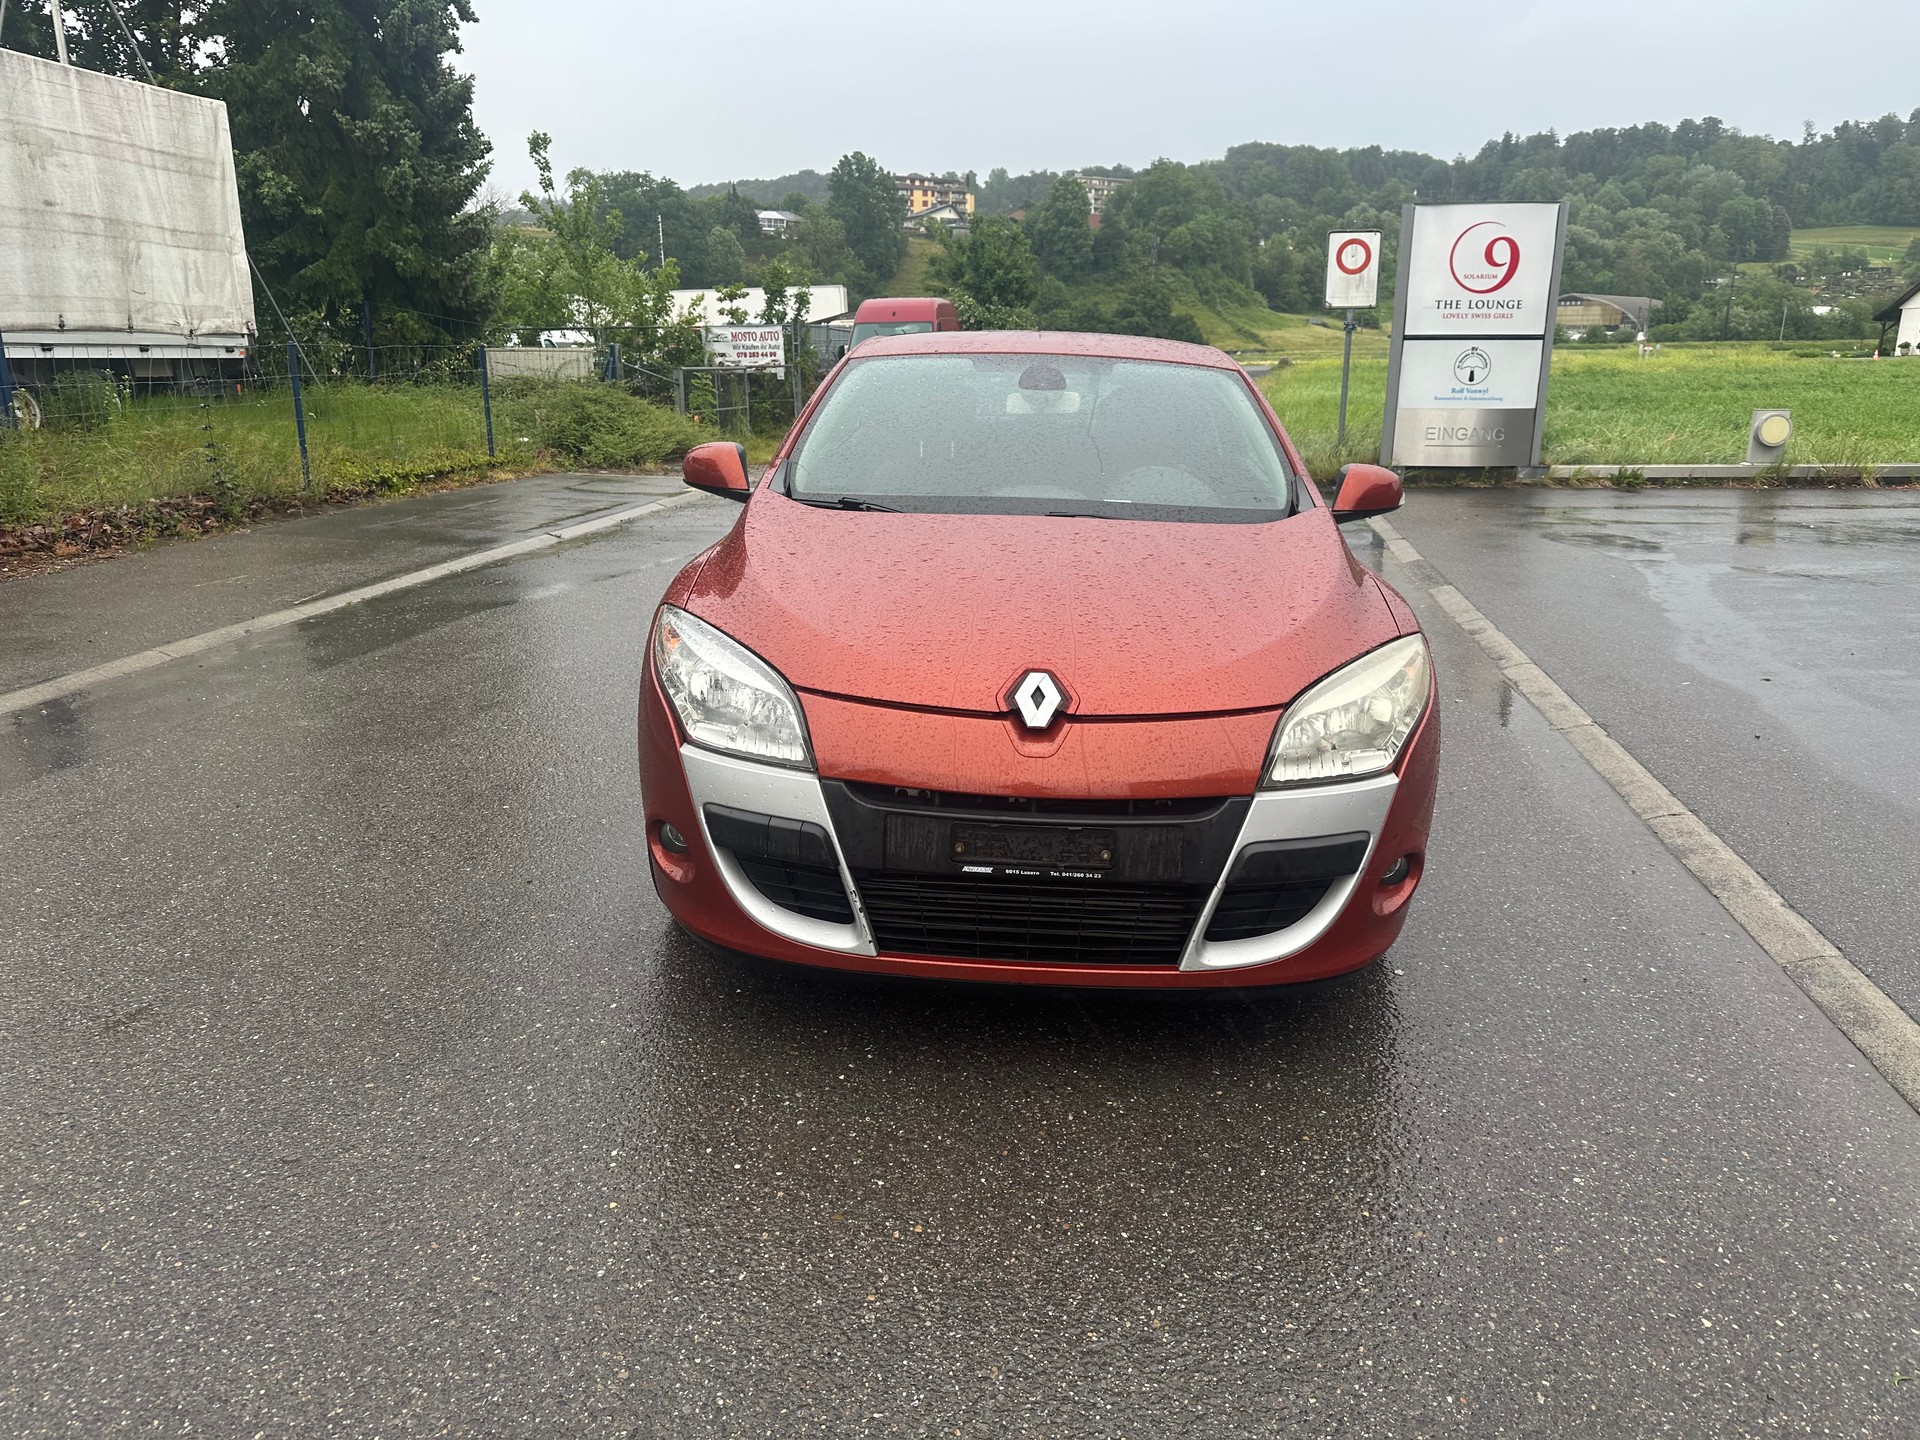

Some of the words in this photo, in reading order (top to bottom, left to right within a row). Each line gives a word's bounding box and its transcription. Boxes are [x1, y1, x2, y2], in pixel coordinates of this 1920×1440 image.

[1435, 299, 1462, 310] THE
[1468, 299, 1523, 310] LOUNGE
[731, 332, 757, 342] MOSTO
[759, 331, 780, 341] AUTO
[1425, 426, 1505, 441] EINGANG
